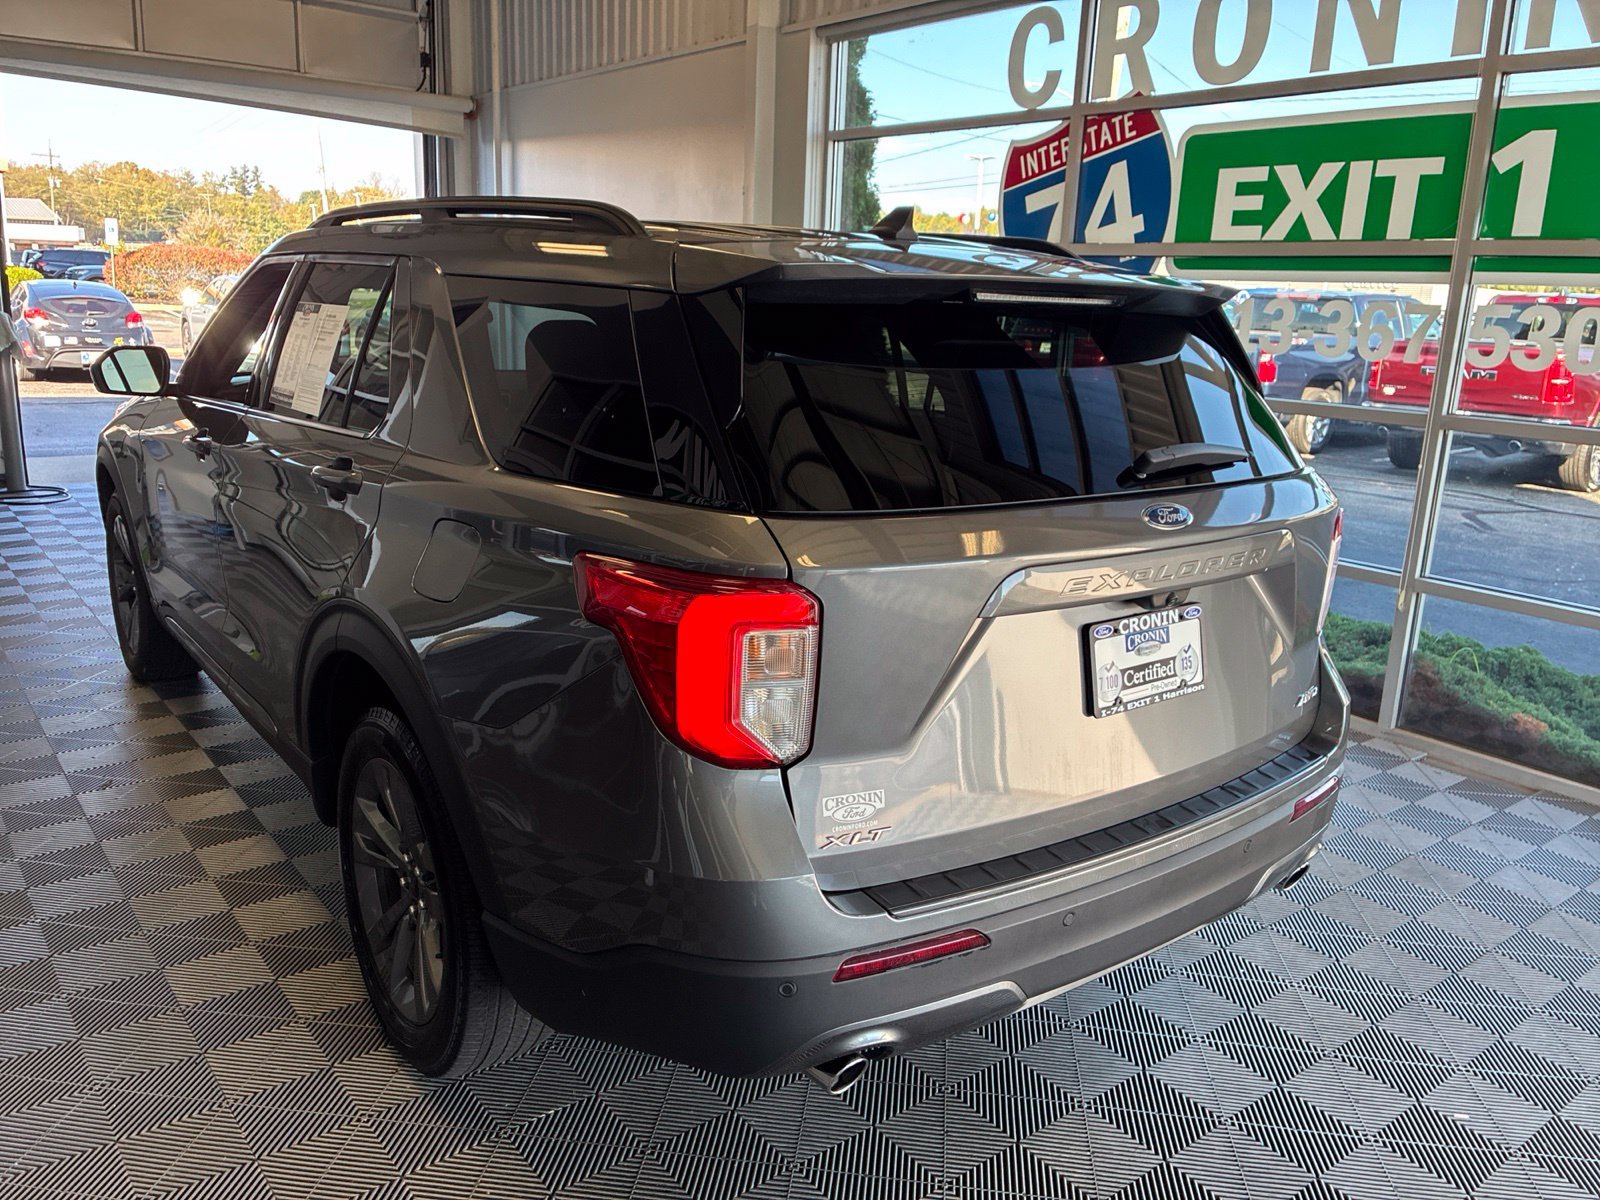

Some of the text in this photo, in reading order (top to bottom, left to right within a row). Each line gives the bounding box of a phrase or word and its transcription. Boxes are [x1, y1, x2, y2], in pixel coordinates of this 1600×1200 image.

[1020, 112, 1137, 179] INTERTATE
[1211, 129, 1557, 241] EXIT 1
[1157, 507, 1188, 524] Ford
[1059, 548, 1267, 598] EXPLORER
[1118, 609, 1179, 634] CRONIN
[1127, 628, 1168, 650] CRONIN
[1124, 660, 1175, 686] Certified
[1101, 683, 1205, 717] I-74 EXIT 1 Harrison
[824, 790, 884, 812] CRONIN
[842, 806, 867, 819] Ford
[819, 825, 893, 850] XLT
